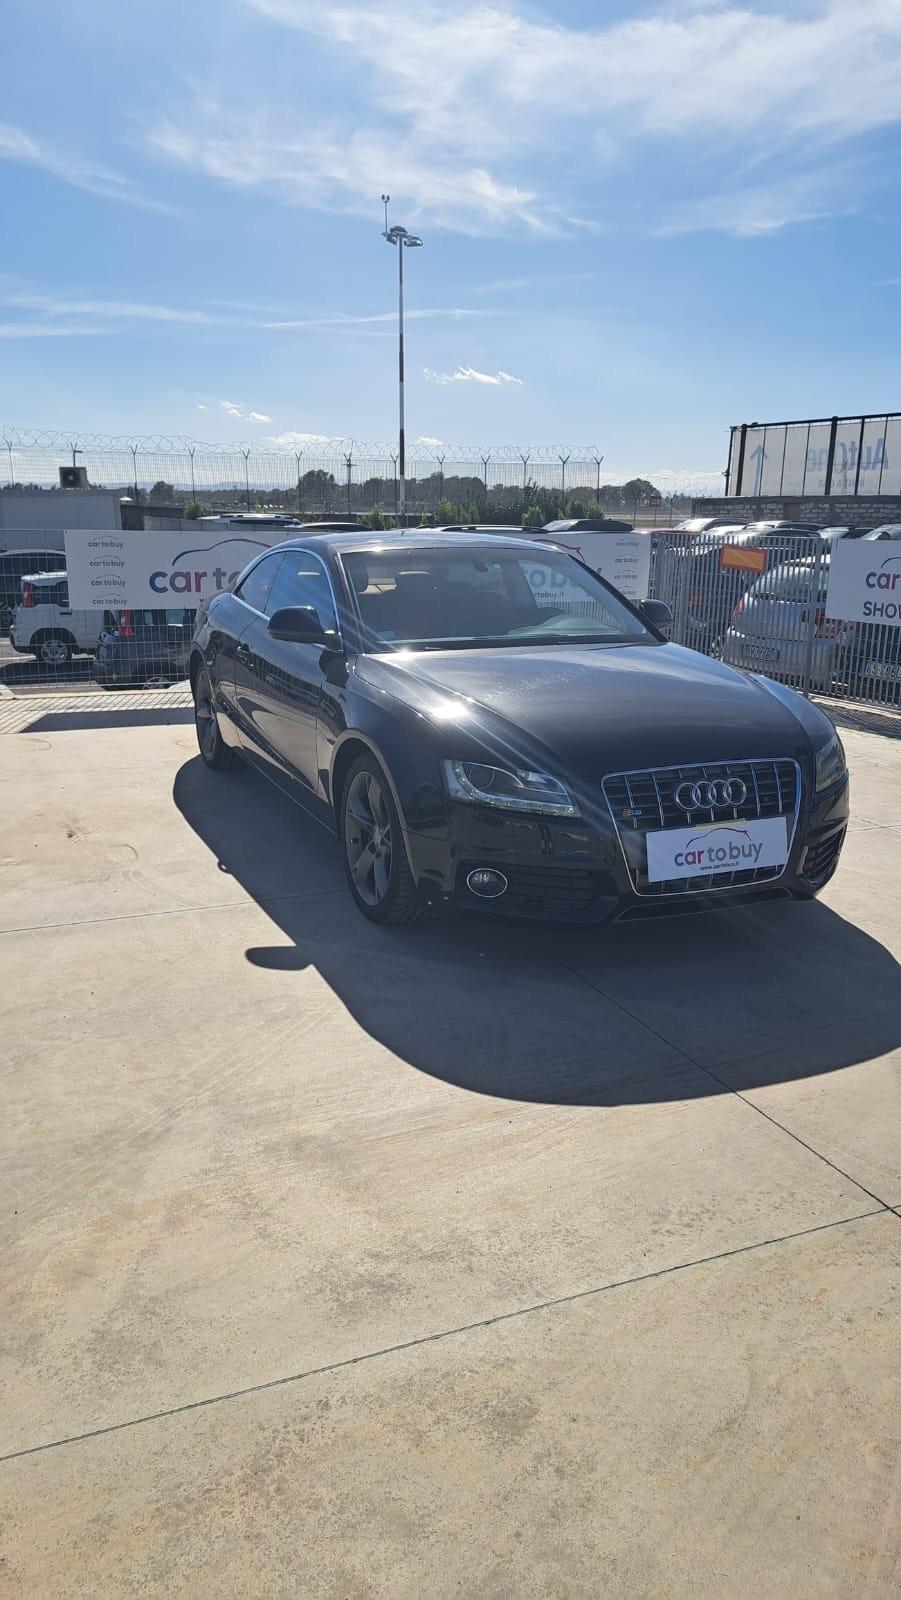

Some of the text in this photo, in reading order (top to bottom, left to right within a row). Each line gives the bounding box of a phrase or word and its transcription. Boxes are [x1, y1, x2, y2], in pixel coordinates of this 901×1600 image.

[149, 571, 208, 593] car
[865, 571, 901, 590] car
[862, 600, 901, 619] SHO
[674, 849, 704, 867] car
